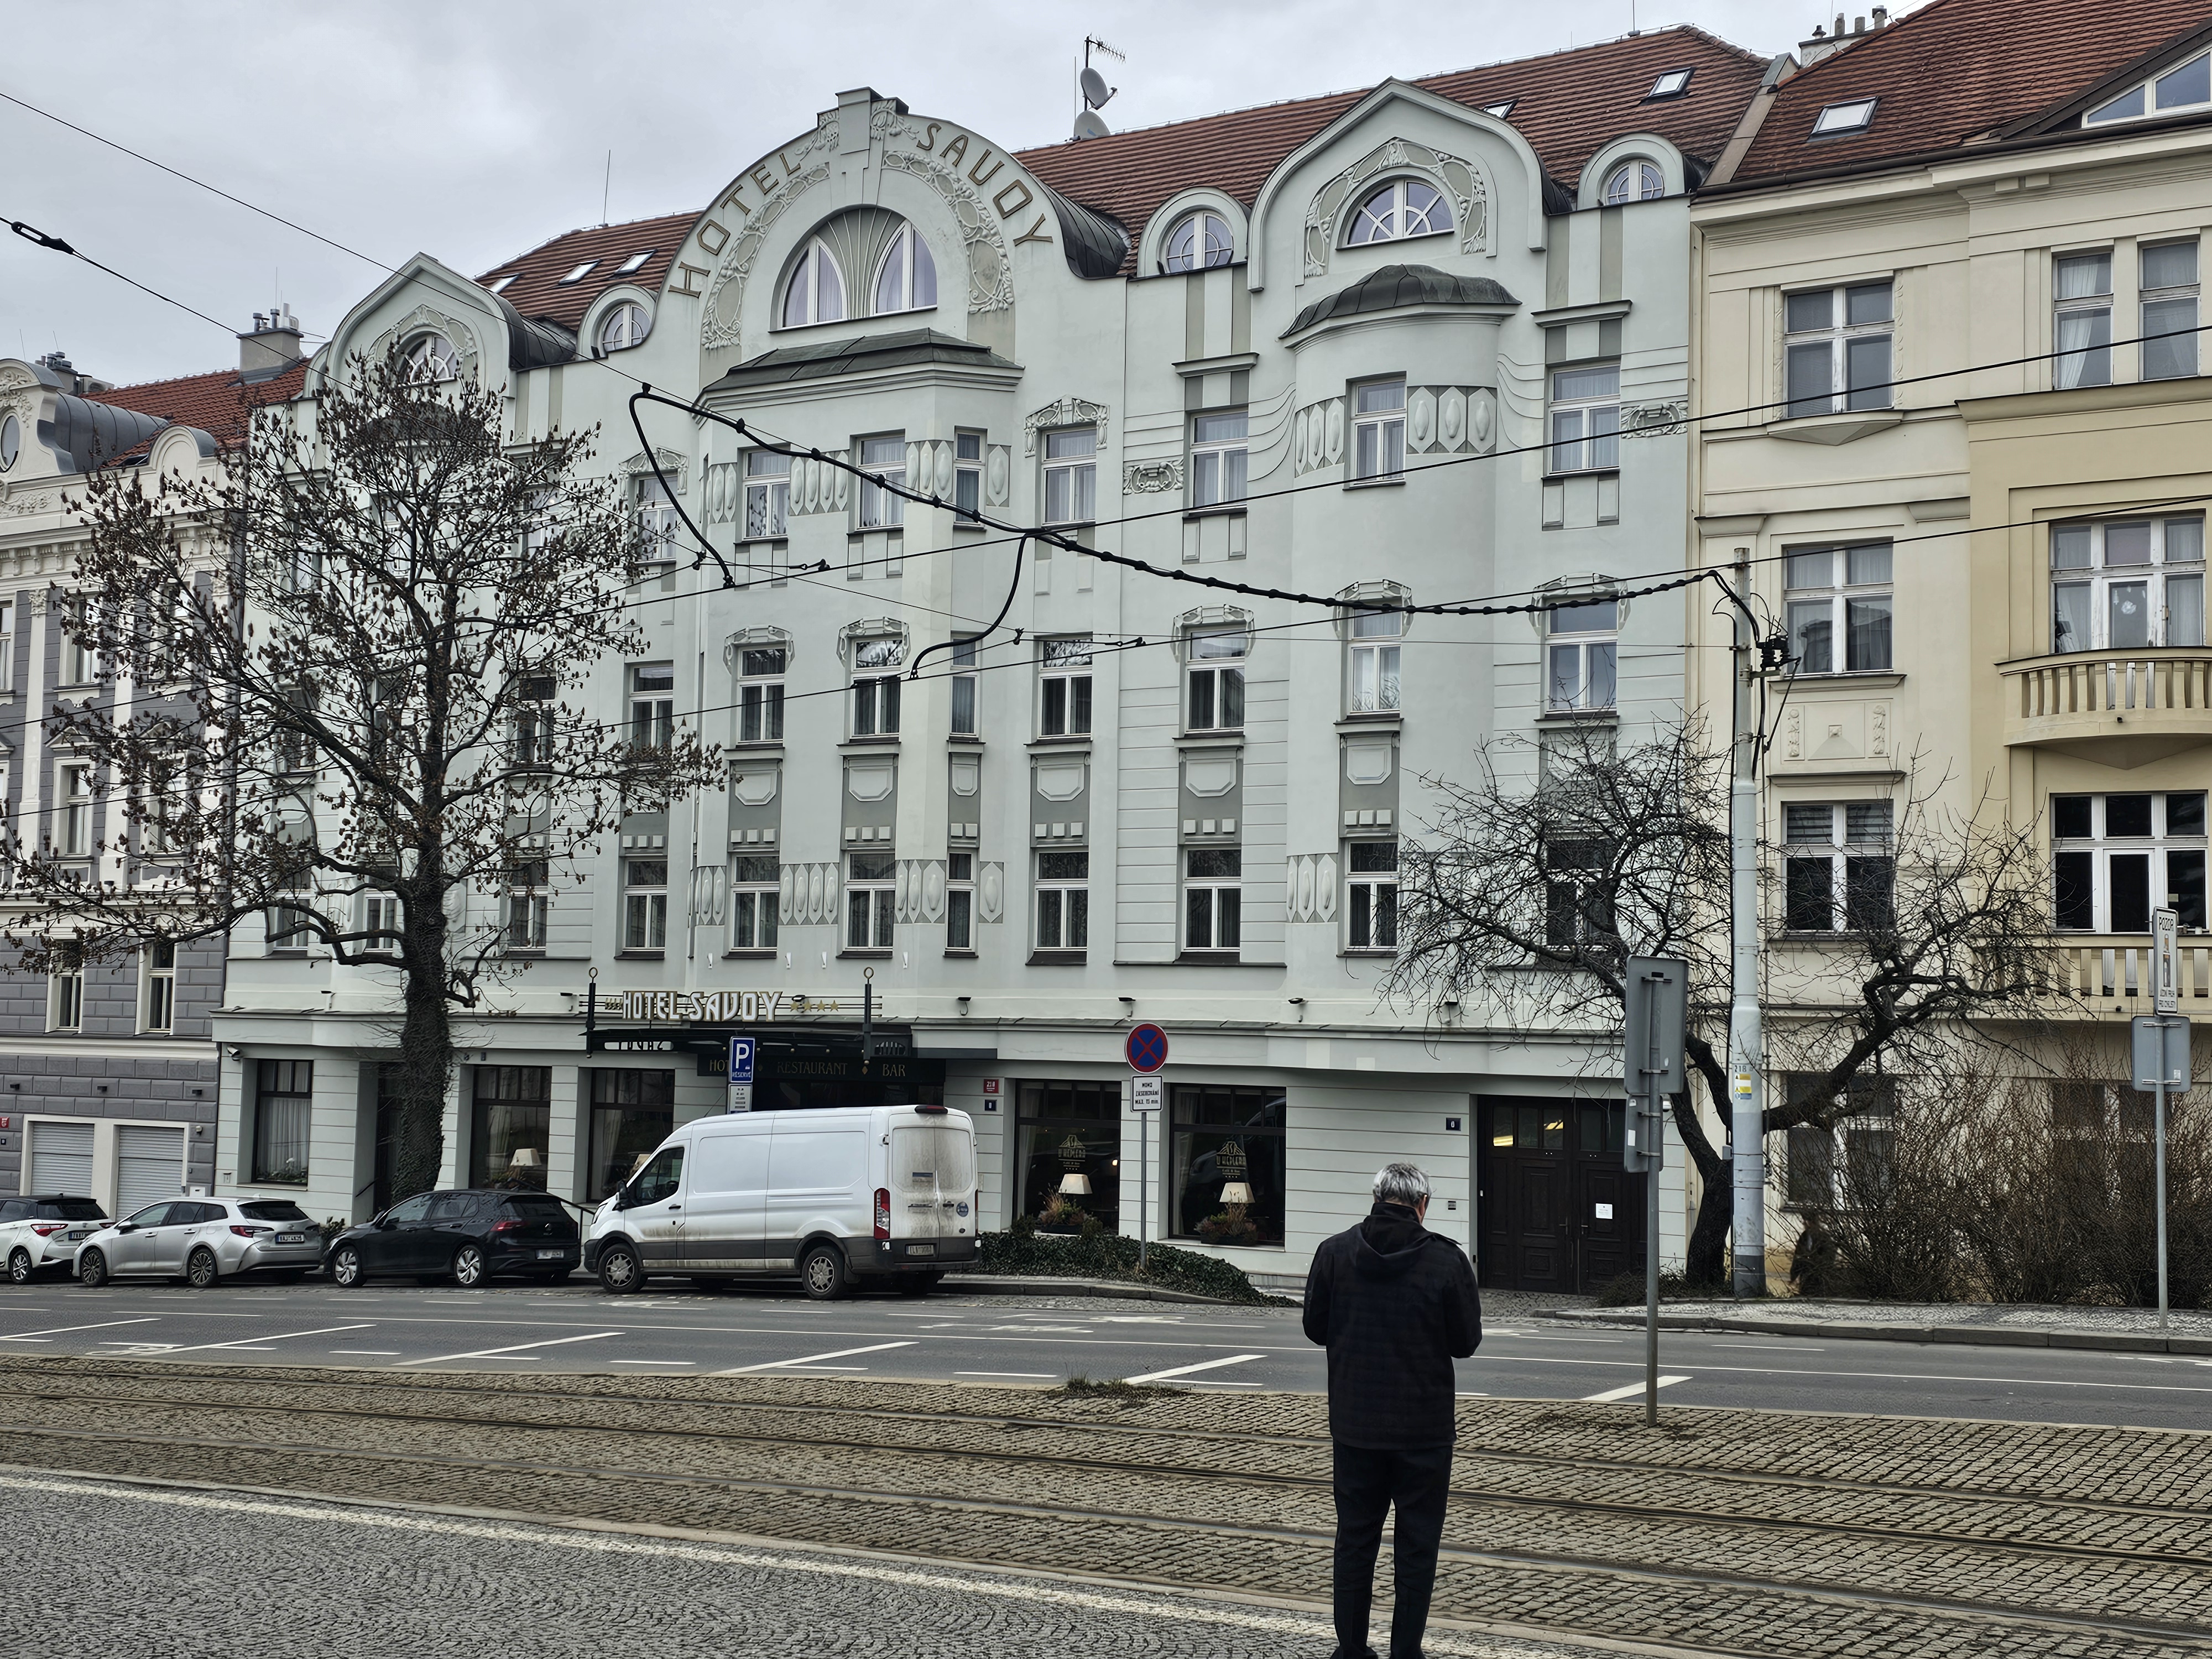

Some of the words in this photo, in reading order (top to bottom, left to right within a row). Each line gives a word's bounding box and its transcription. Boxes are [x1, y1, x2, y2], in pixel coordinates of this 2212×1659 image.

[668, 153, 801, 299] HOTEL
[916, 122, 1053, 247] SAVOY
[2158, 916, 2174, 931] POZOR
[623, 990, 683, 1020] HOTEL
[688, 991, 783, 1022] SAVOY
[735, 1043, 749, 1069] P
[777, 1062, 848, 1075] RESTAURANT
[883, 1064, 906, 1077] BAR
